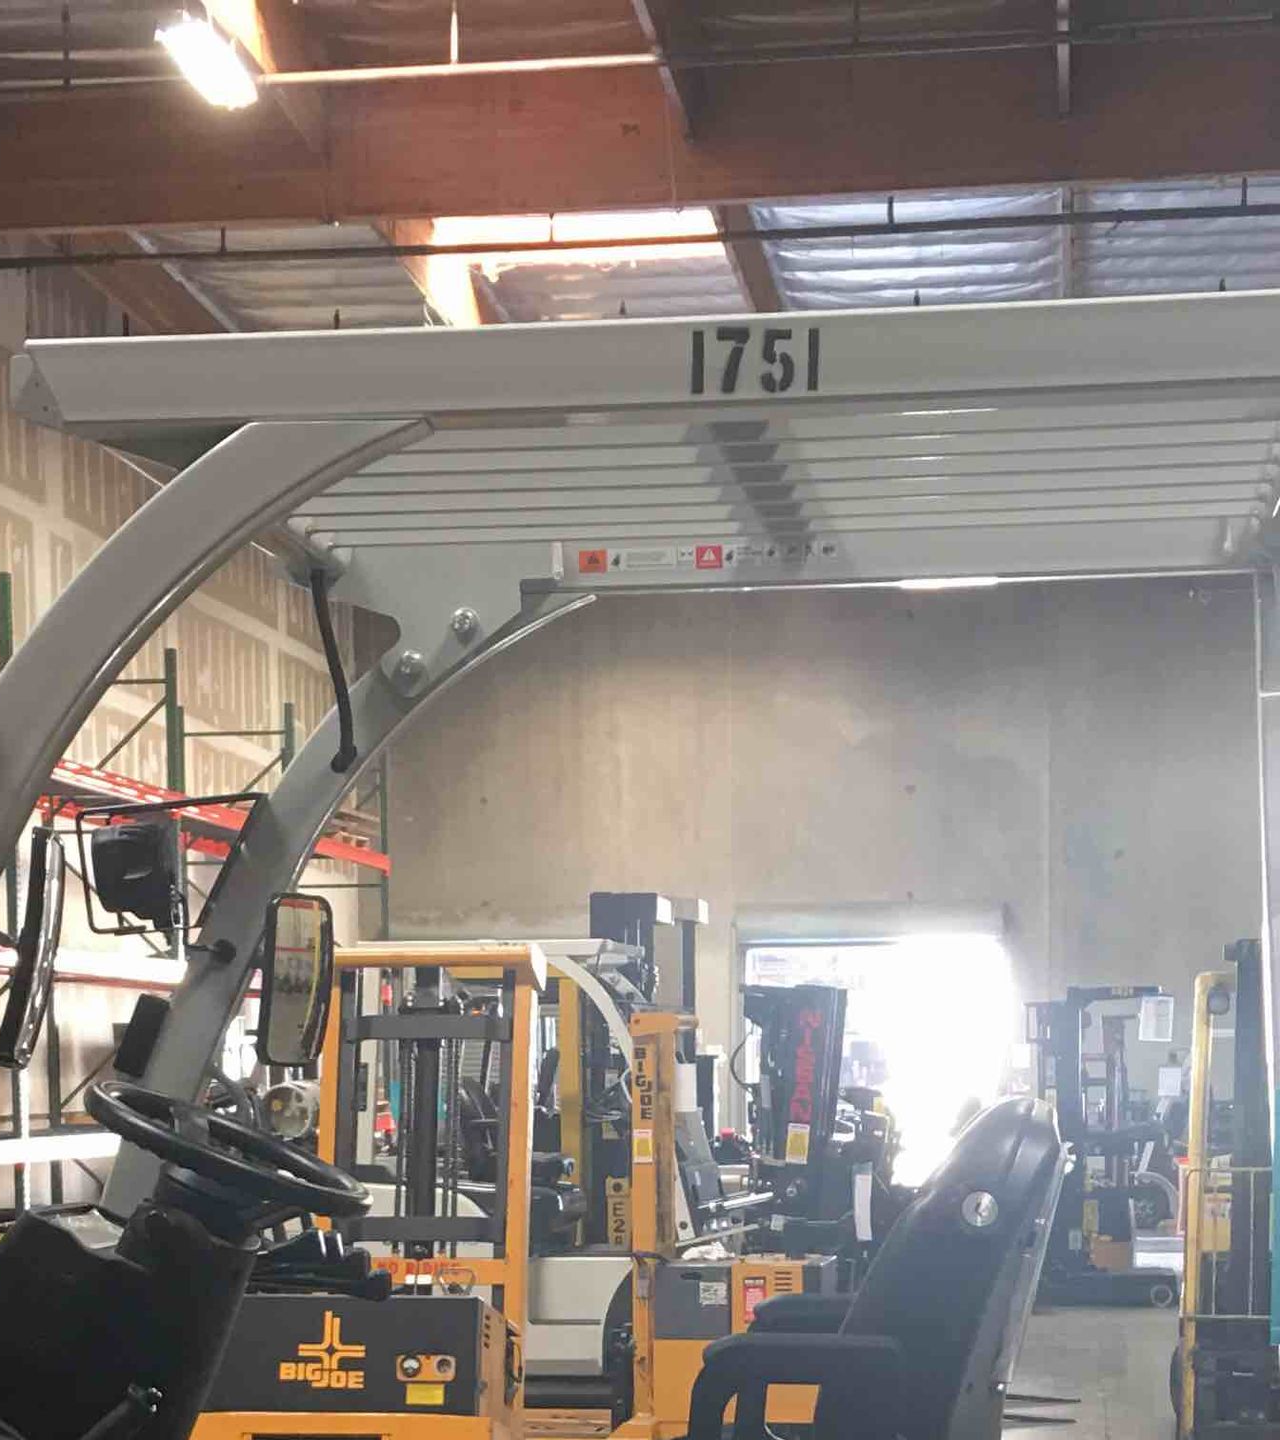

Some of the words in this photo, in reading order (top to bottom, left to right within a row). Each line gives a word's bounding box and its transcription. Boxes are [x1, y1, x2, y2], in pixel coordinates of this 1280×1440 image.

[691, 326, 820, 395] 1751
[279, 1361, 322, 1381] BIG
[311, 1370, 365, 1390] JOE
